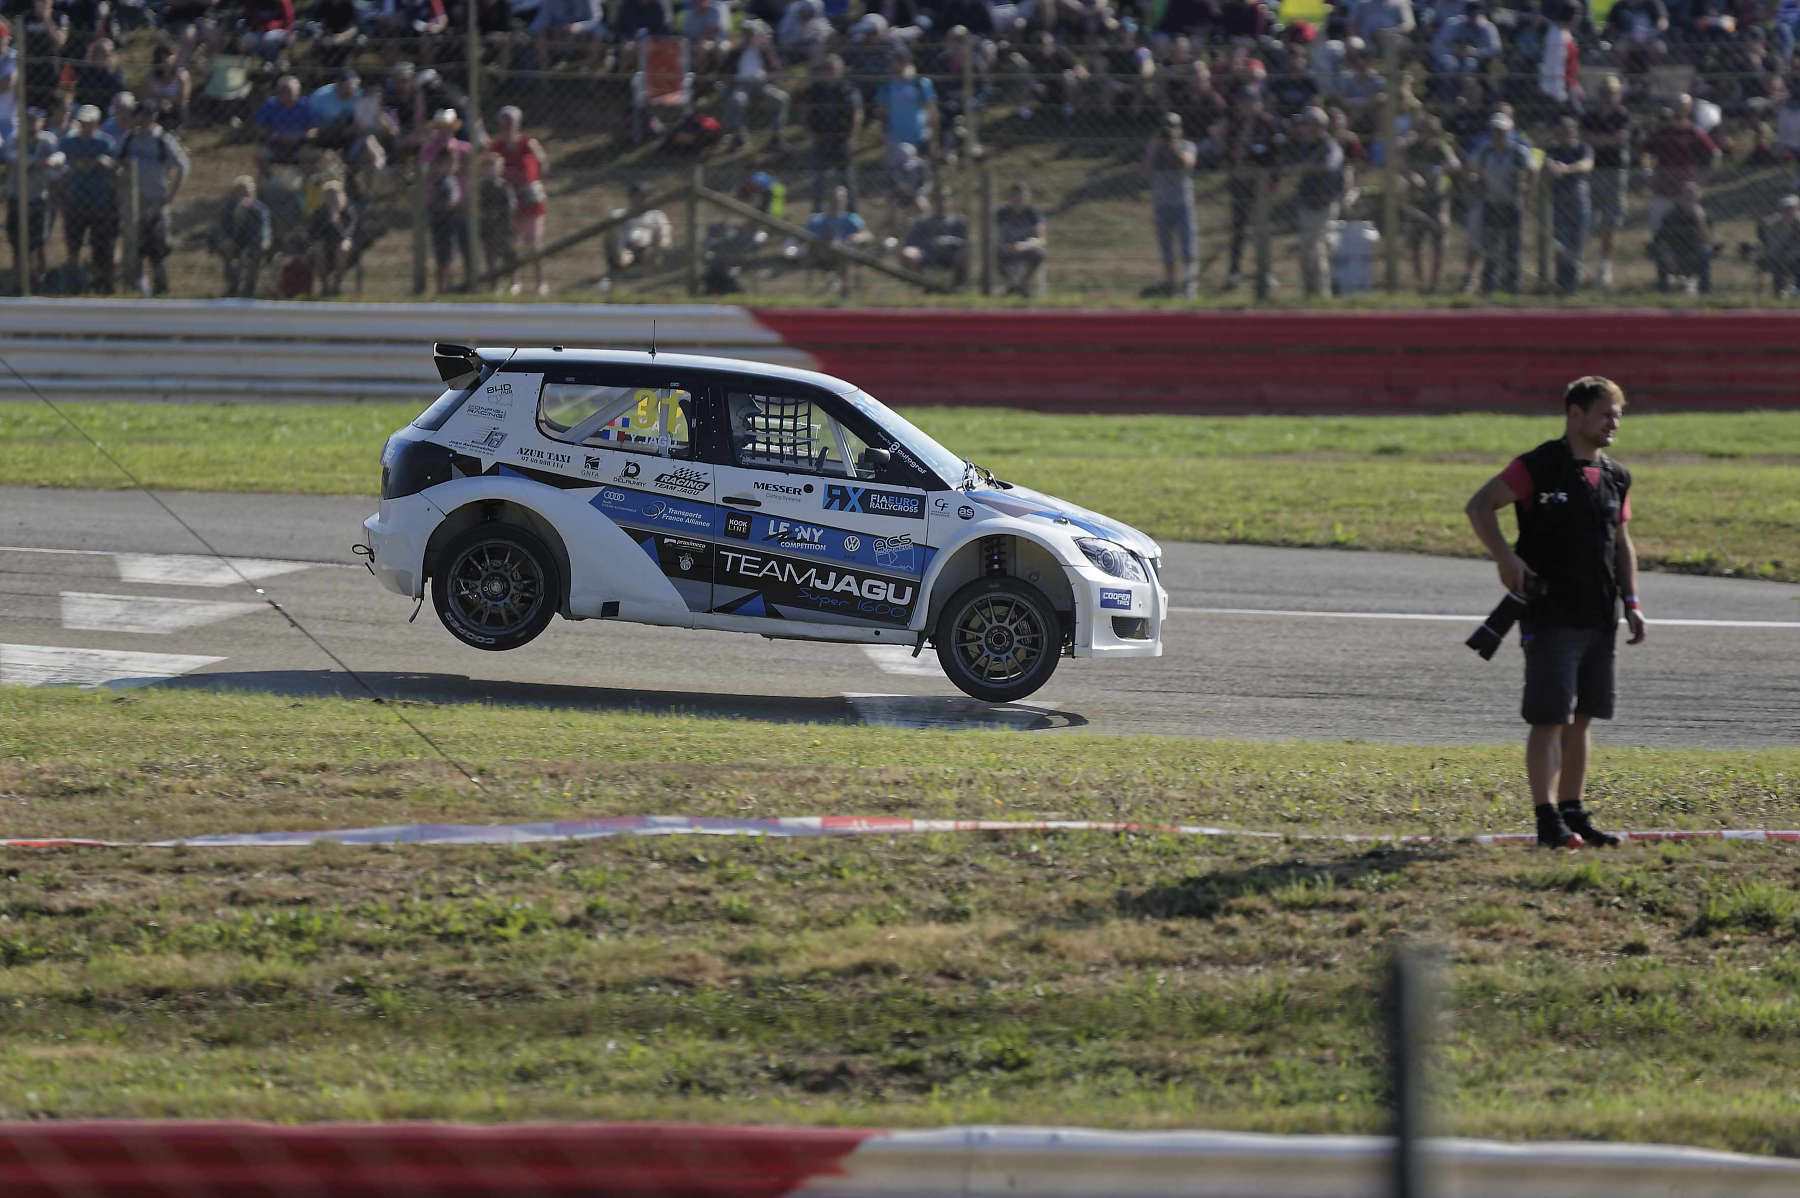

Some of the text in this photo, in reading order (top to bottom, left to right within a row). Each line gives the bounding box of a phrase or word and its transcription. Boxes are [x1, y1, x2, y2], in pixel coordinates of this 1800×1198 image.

[516, 447, 571, 464] AZUR TAXI
[655, 482, 701, 496] TEAM JAGU
[660, 475, 707, 490] RACING
[753, 481, 802, 496] MESSER
[869, 502, 919, 513] RALLYCROSS
[728, 525, 747, 533] LINE
[780, 541, 827, 551] COMPETITION
[873, 533, 913, 552] ACS
[798, 587, 907, 618] Super 1600
[1102, 592, 1131, 601] COOPER
